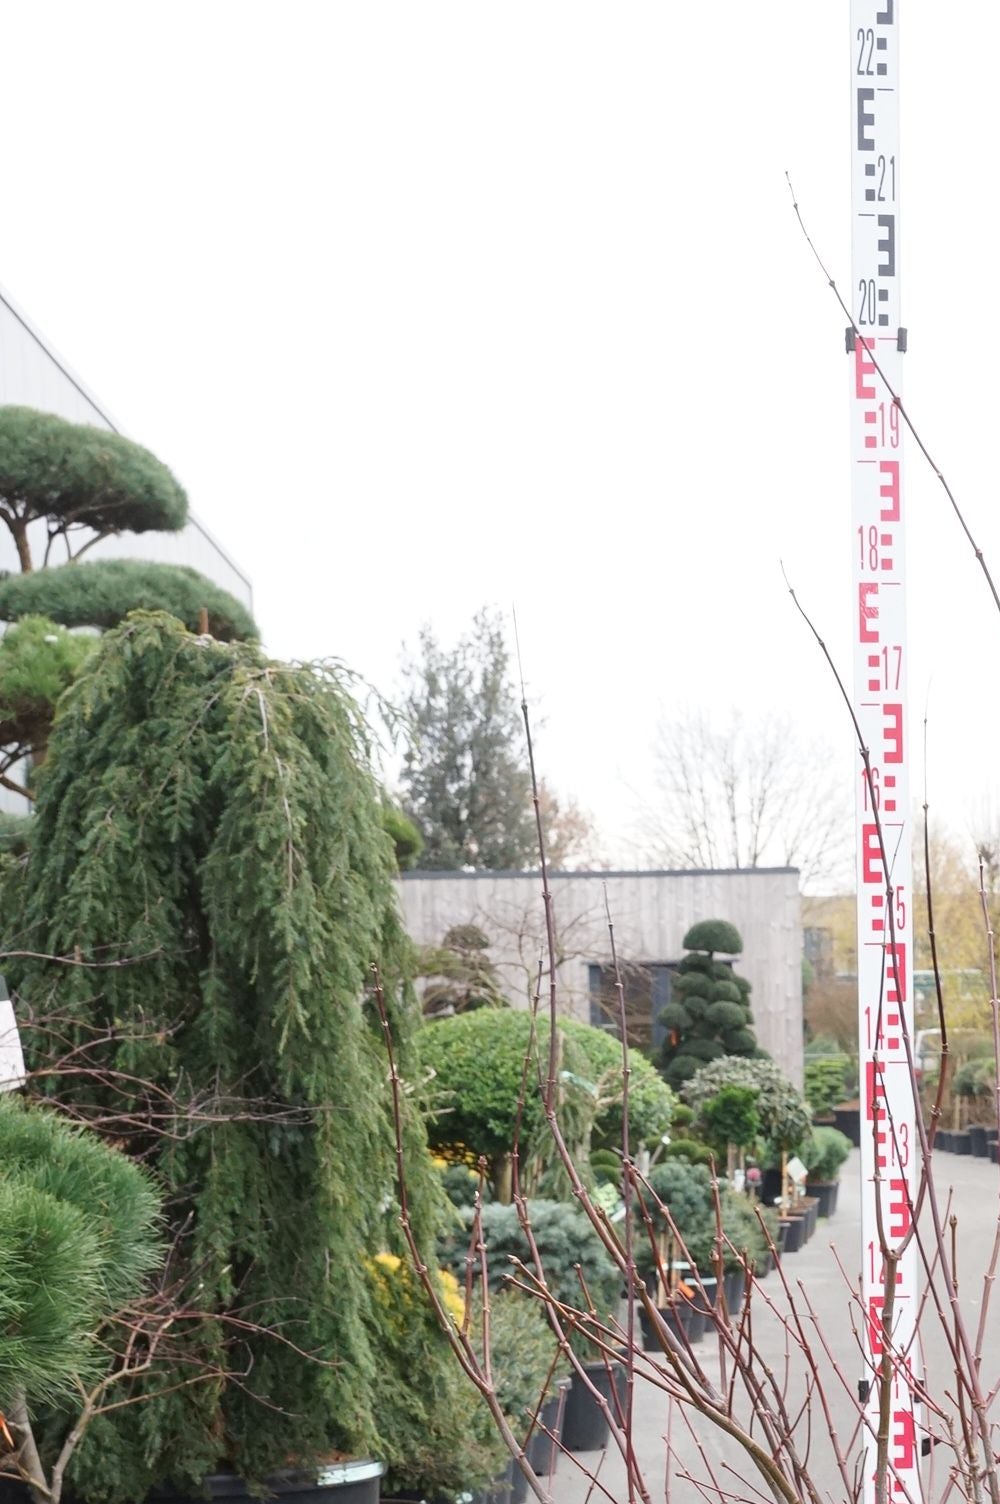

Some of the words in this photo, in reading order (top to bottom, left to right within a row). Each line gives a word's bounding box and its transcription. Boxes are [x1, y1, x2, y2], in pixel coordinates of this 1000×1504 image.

[857, 28, 875, 76] 22
[877, 154, 896, 202] 21
[858, 278, 876, 326] 20
[879, 402, 900, 448] 19
[857, 525, 878, 571] 18
[882, 646, 902, 690] 17
